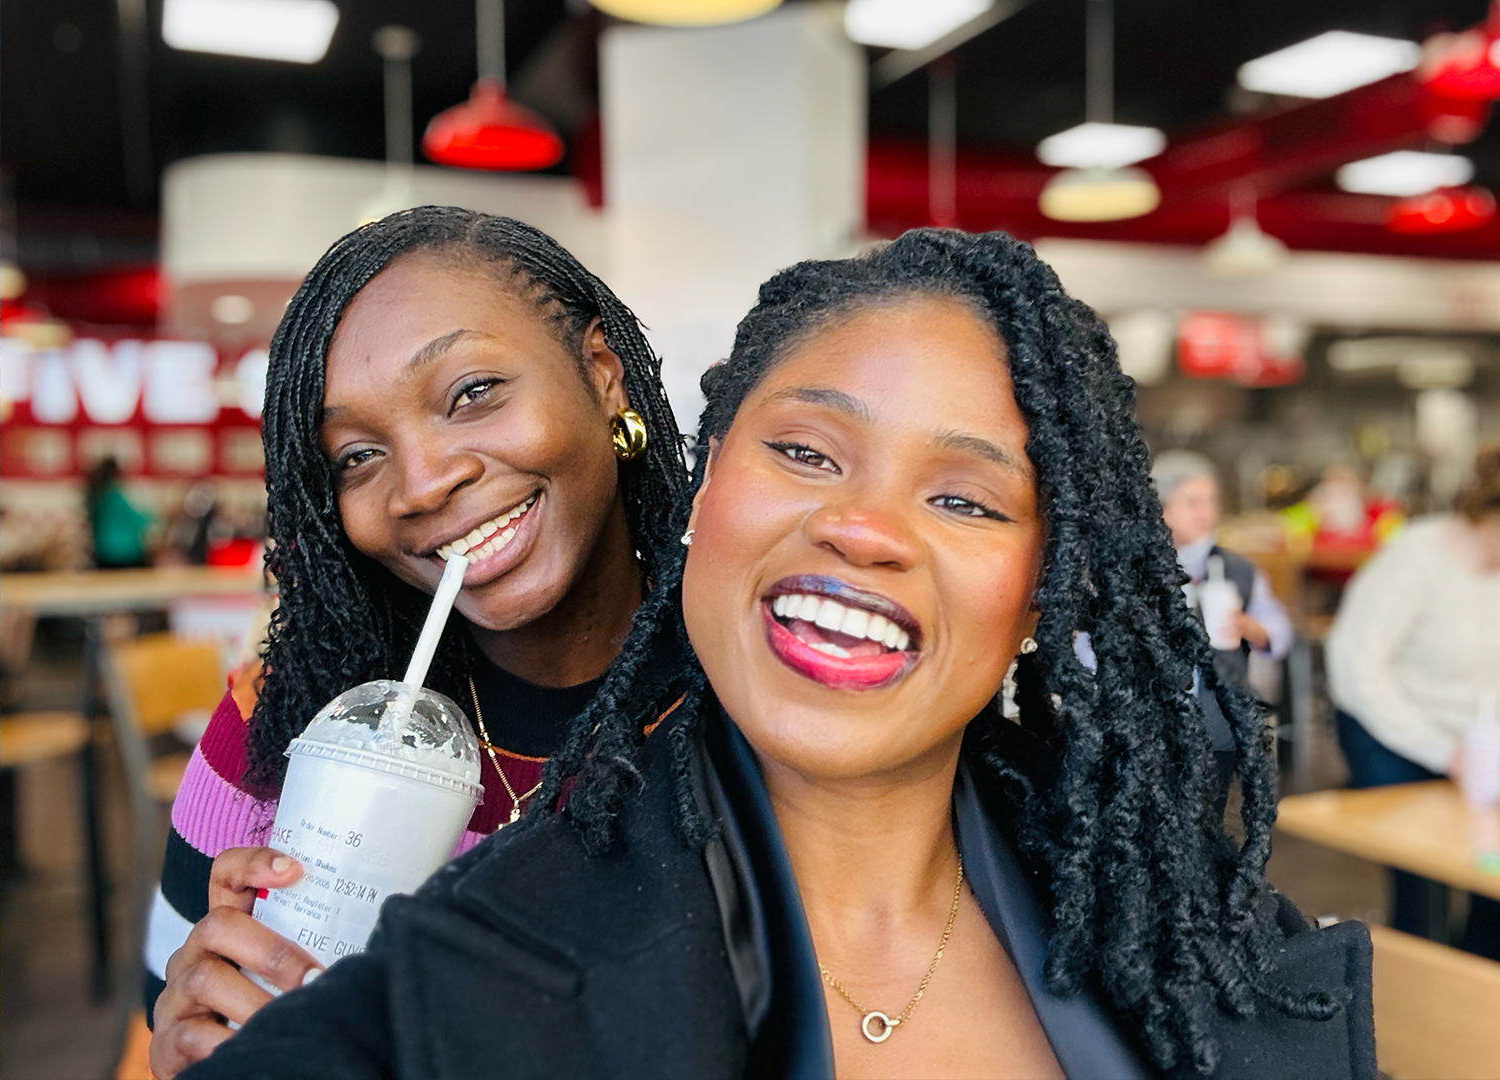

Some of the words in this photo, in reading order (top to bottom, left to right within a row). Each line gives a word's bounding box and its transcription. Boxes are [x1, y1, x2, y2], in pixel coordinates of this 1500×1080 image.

[345, 830, 363, 848] 36
[333, 878, 367, 900] 12:52:14
[366, 887, 379, 904] PM
[297, 927, 330, 952] FIVE
